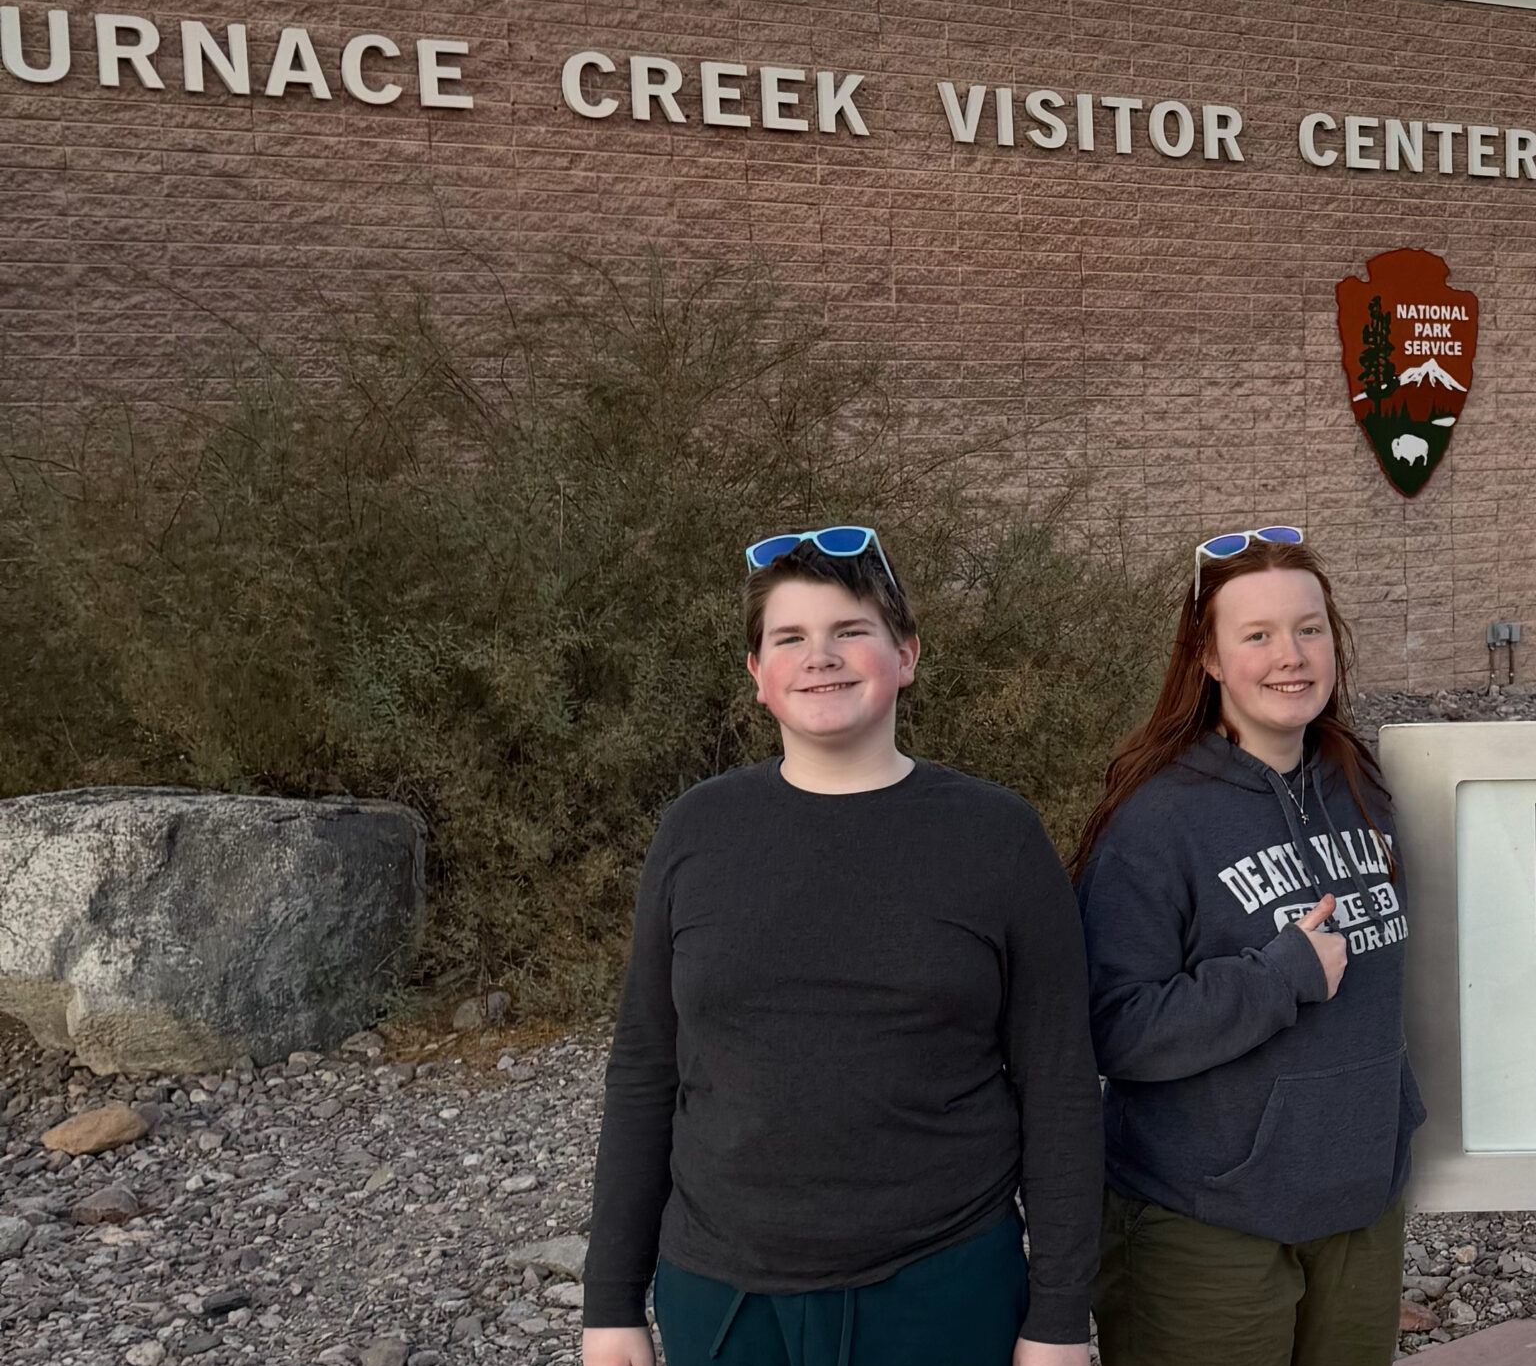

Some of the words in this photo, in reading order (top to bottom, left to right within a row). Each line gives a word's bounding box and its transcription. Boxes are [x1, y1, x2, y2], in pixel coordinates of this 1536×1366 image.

[1, 6, 475, 109] URNACE
[561, 51, 871, 137] CREEK
[938, 82, 1244, 162] VISITOR
[1396, 304, 1469, 321] NATIONAL
[1414, 322, 1452, 338] PARK
[1404, 340, 1462, 356] SERVICE
